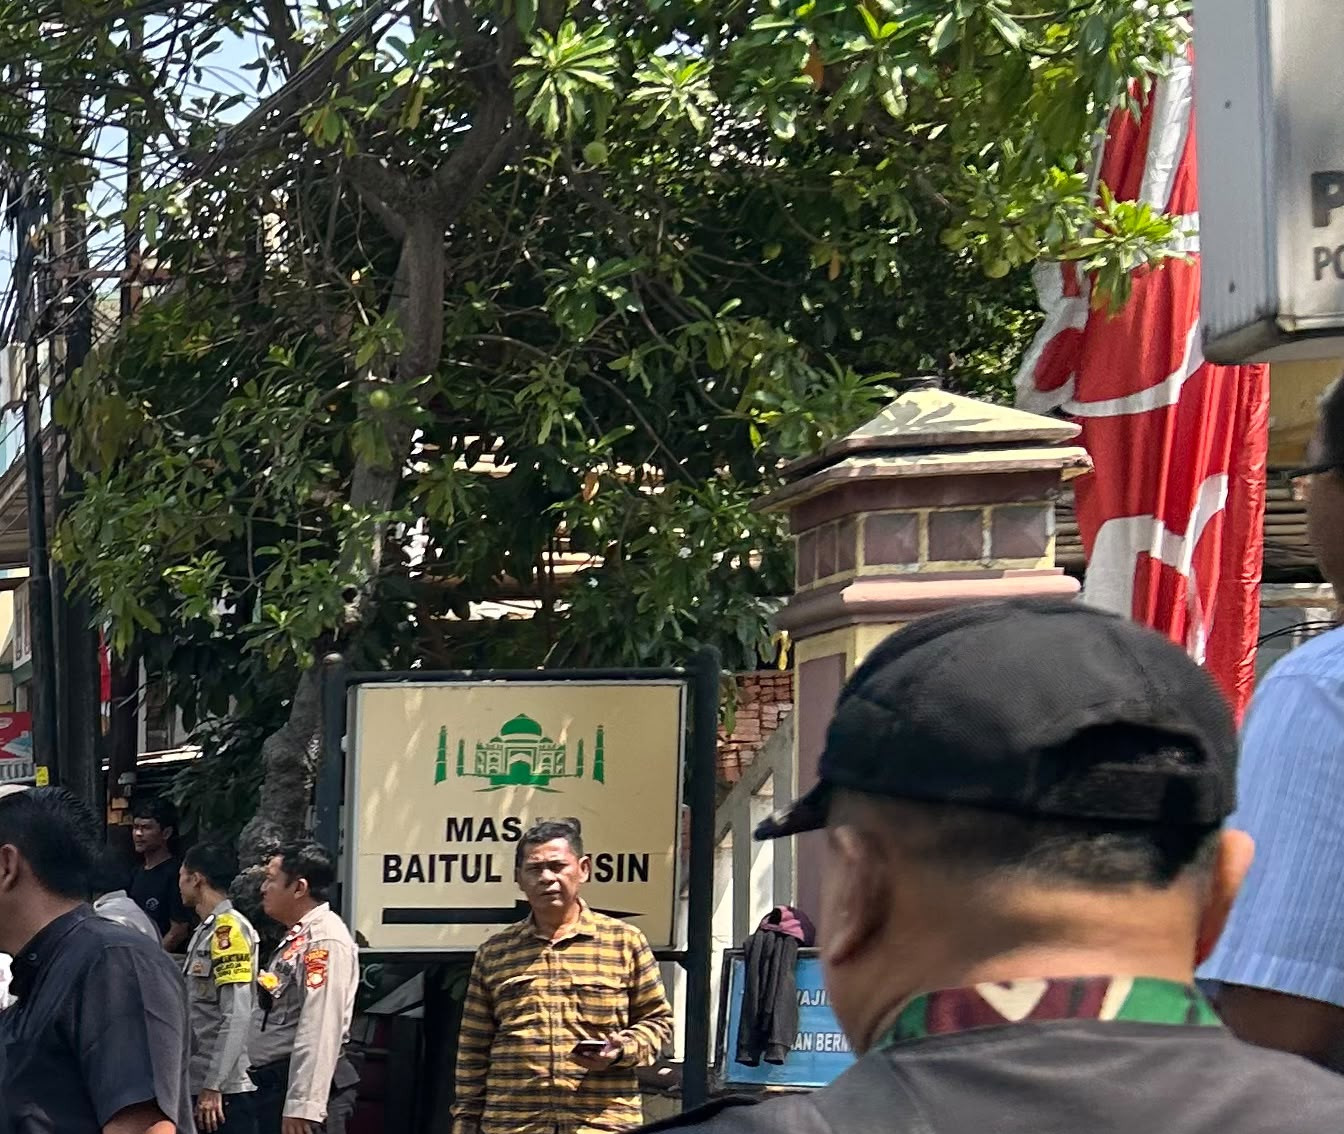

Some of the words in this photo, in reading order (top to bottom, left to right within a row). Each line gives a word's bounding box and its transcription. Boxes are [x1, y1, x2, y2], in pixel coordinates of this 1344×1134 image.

[445, 816, 522, 843] MAS
[382, 853, 502, 884] BAITUL
[791, 1032, 813, 1052] AN
